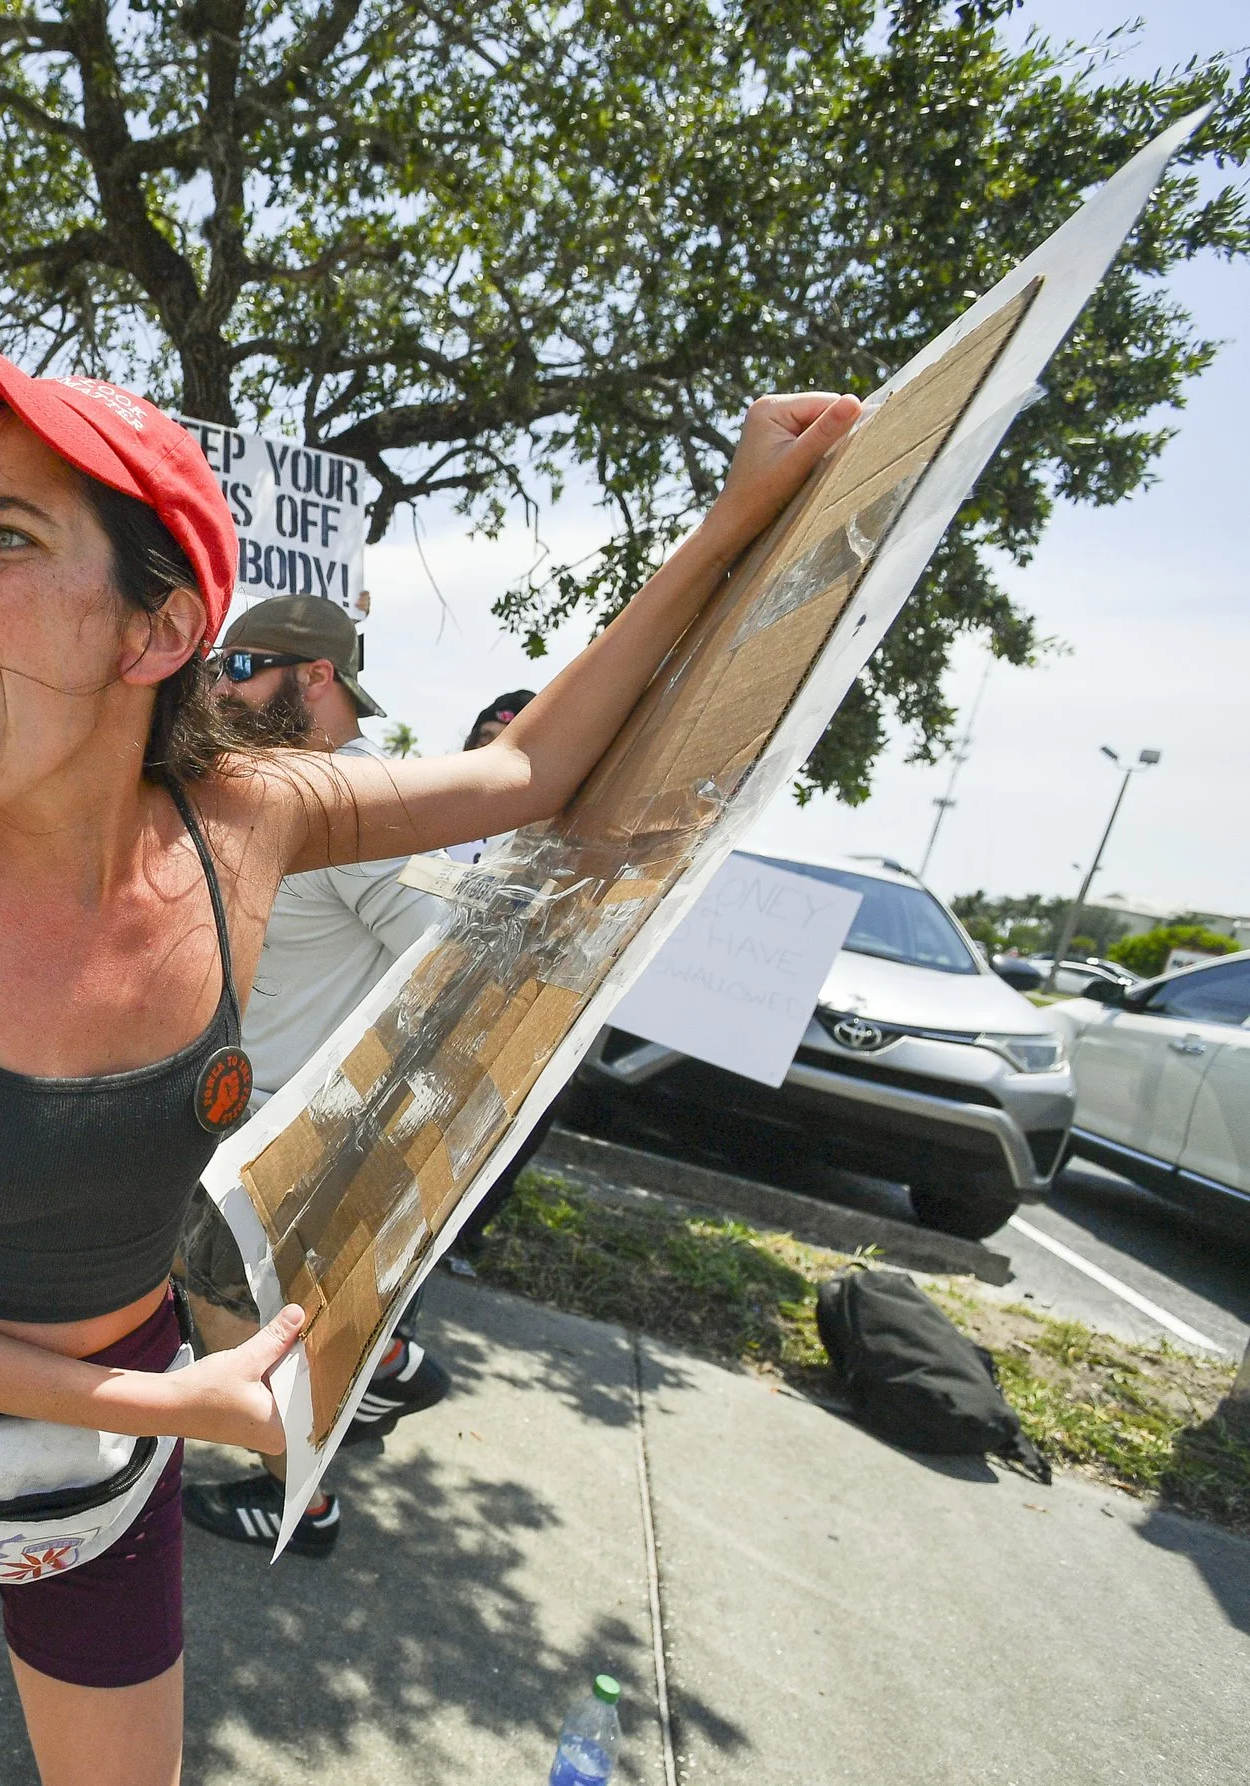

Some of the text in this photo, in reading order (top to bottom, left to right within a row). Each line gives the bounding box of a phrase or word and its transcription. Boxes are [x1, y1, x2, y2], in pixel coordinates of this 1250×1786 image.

[182, 419, 246, 474] EP
[265, 441, 359, 506] YOUR
[275, 494, 341, 549] OFF
[238, 537, 350, 608] BODY!
[712, 876, 840, 928] ONEY
[707, 922, 806, 978] HAVE
[204, 1062, 225, 1107] POWER
[226, 1055, 238, 1067] TO
